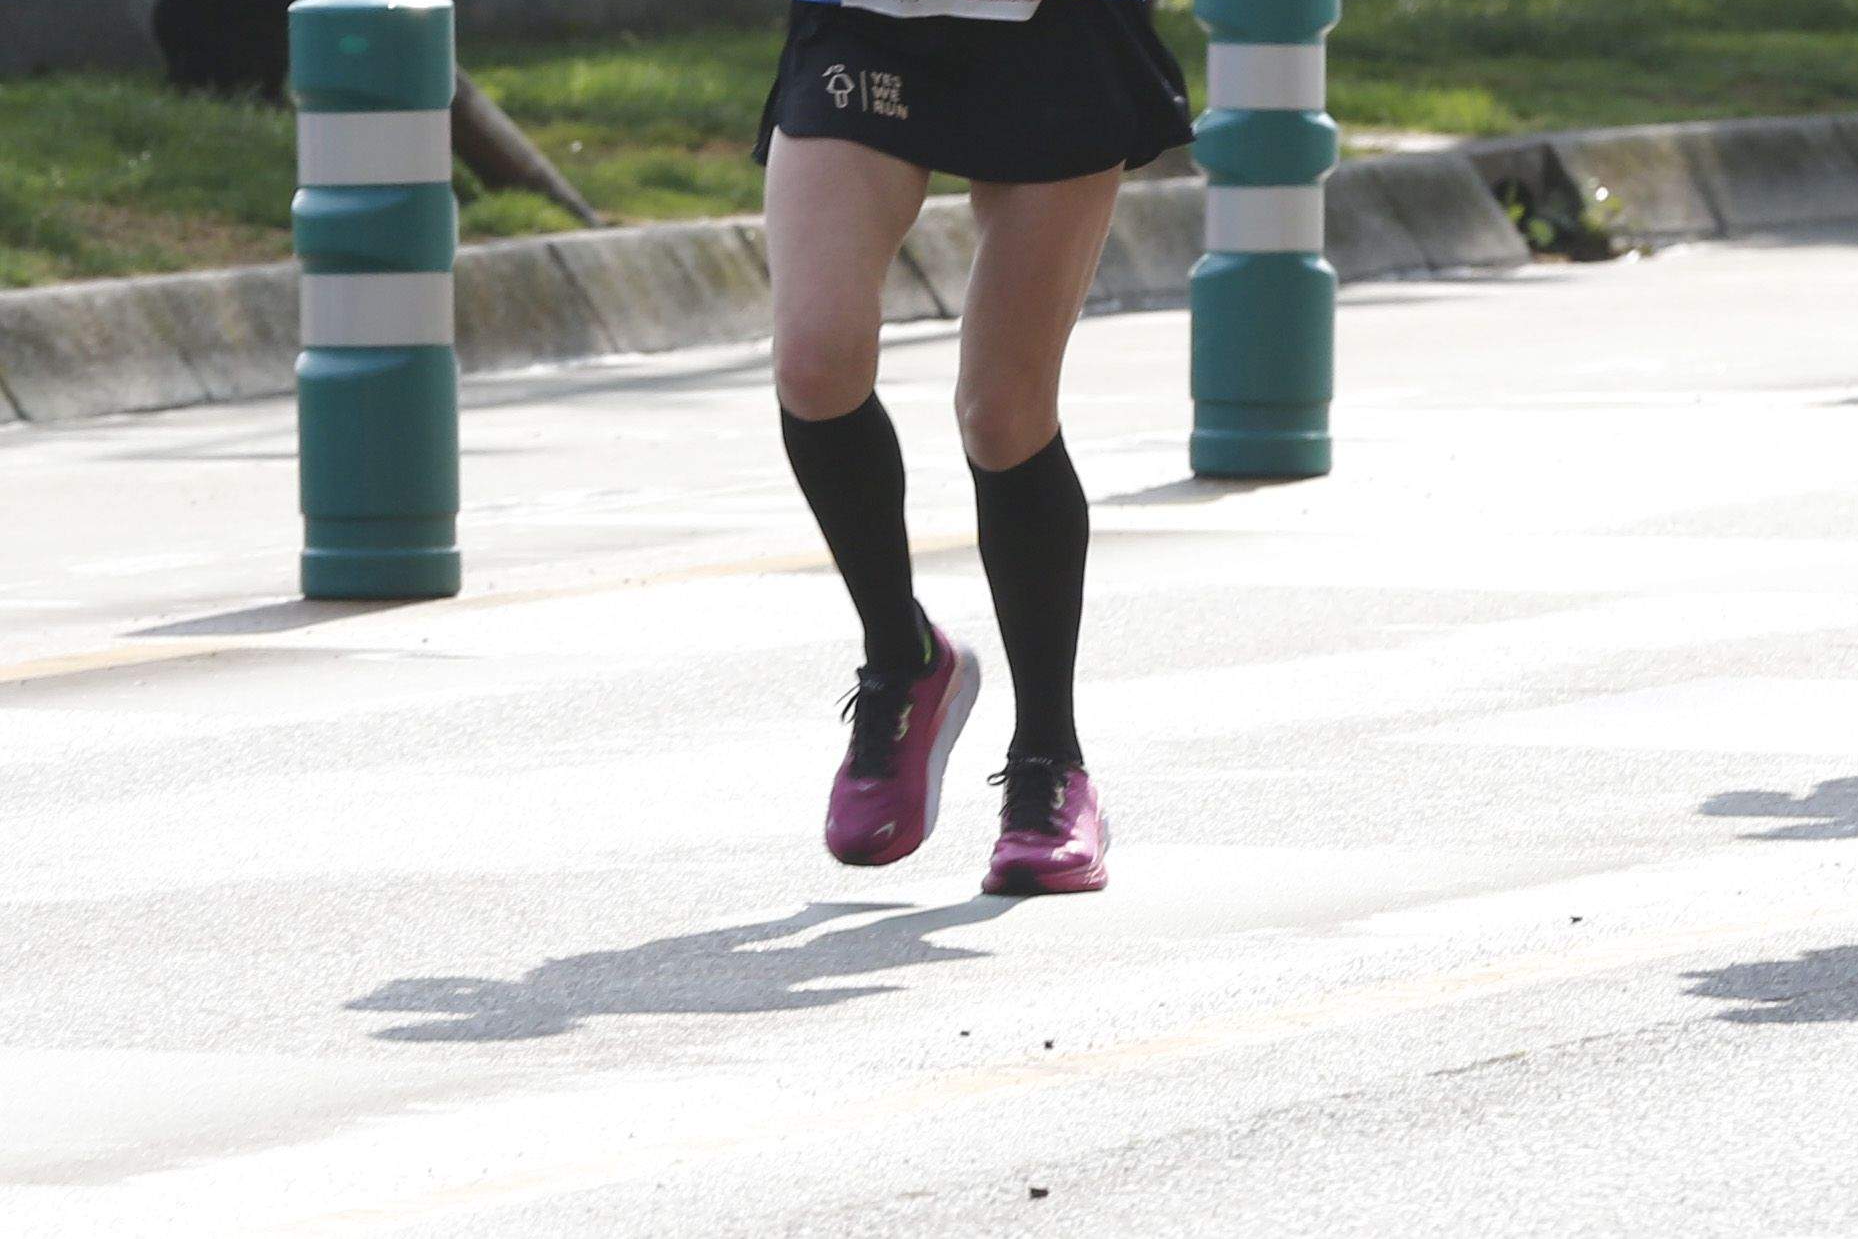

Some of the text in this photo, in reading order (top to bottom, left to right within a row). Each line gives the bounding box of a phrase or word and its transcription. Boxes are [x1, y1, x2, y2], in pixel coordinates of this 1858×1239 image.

[871, 71, 901, 87] YES
[873, 84, 900, 101] WE
[872, 98, 908, 120] RUN
